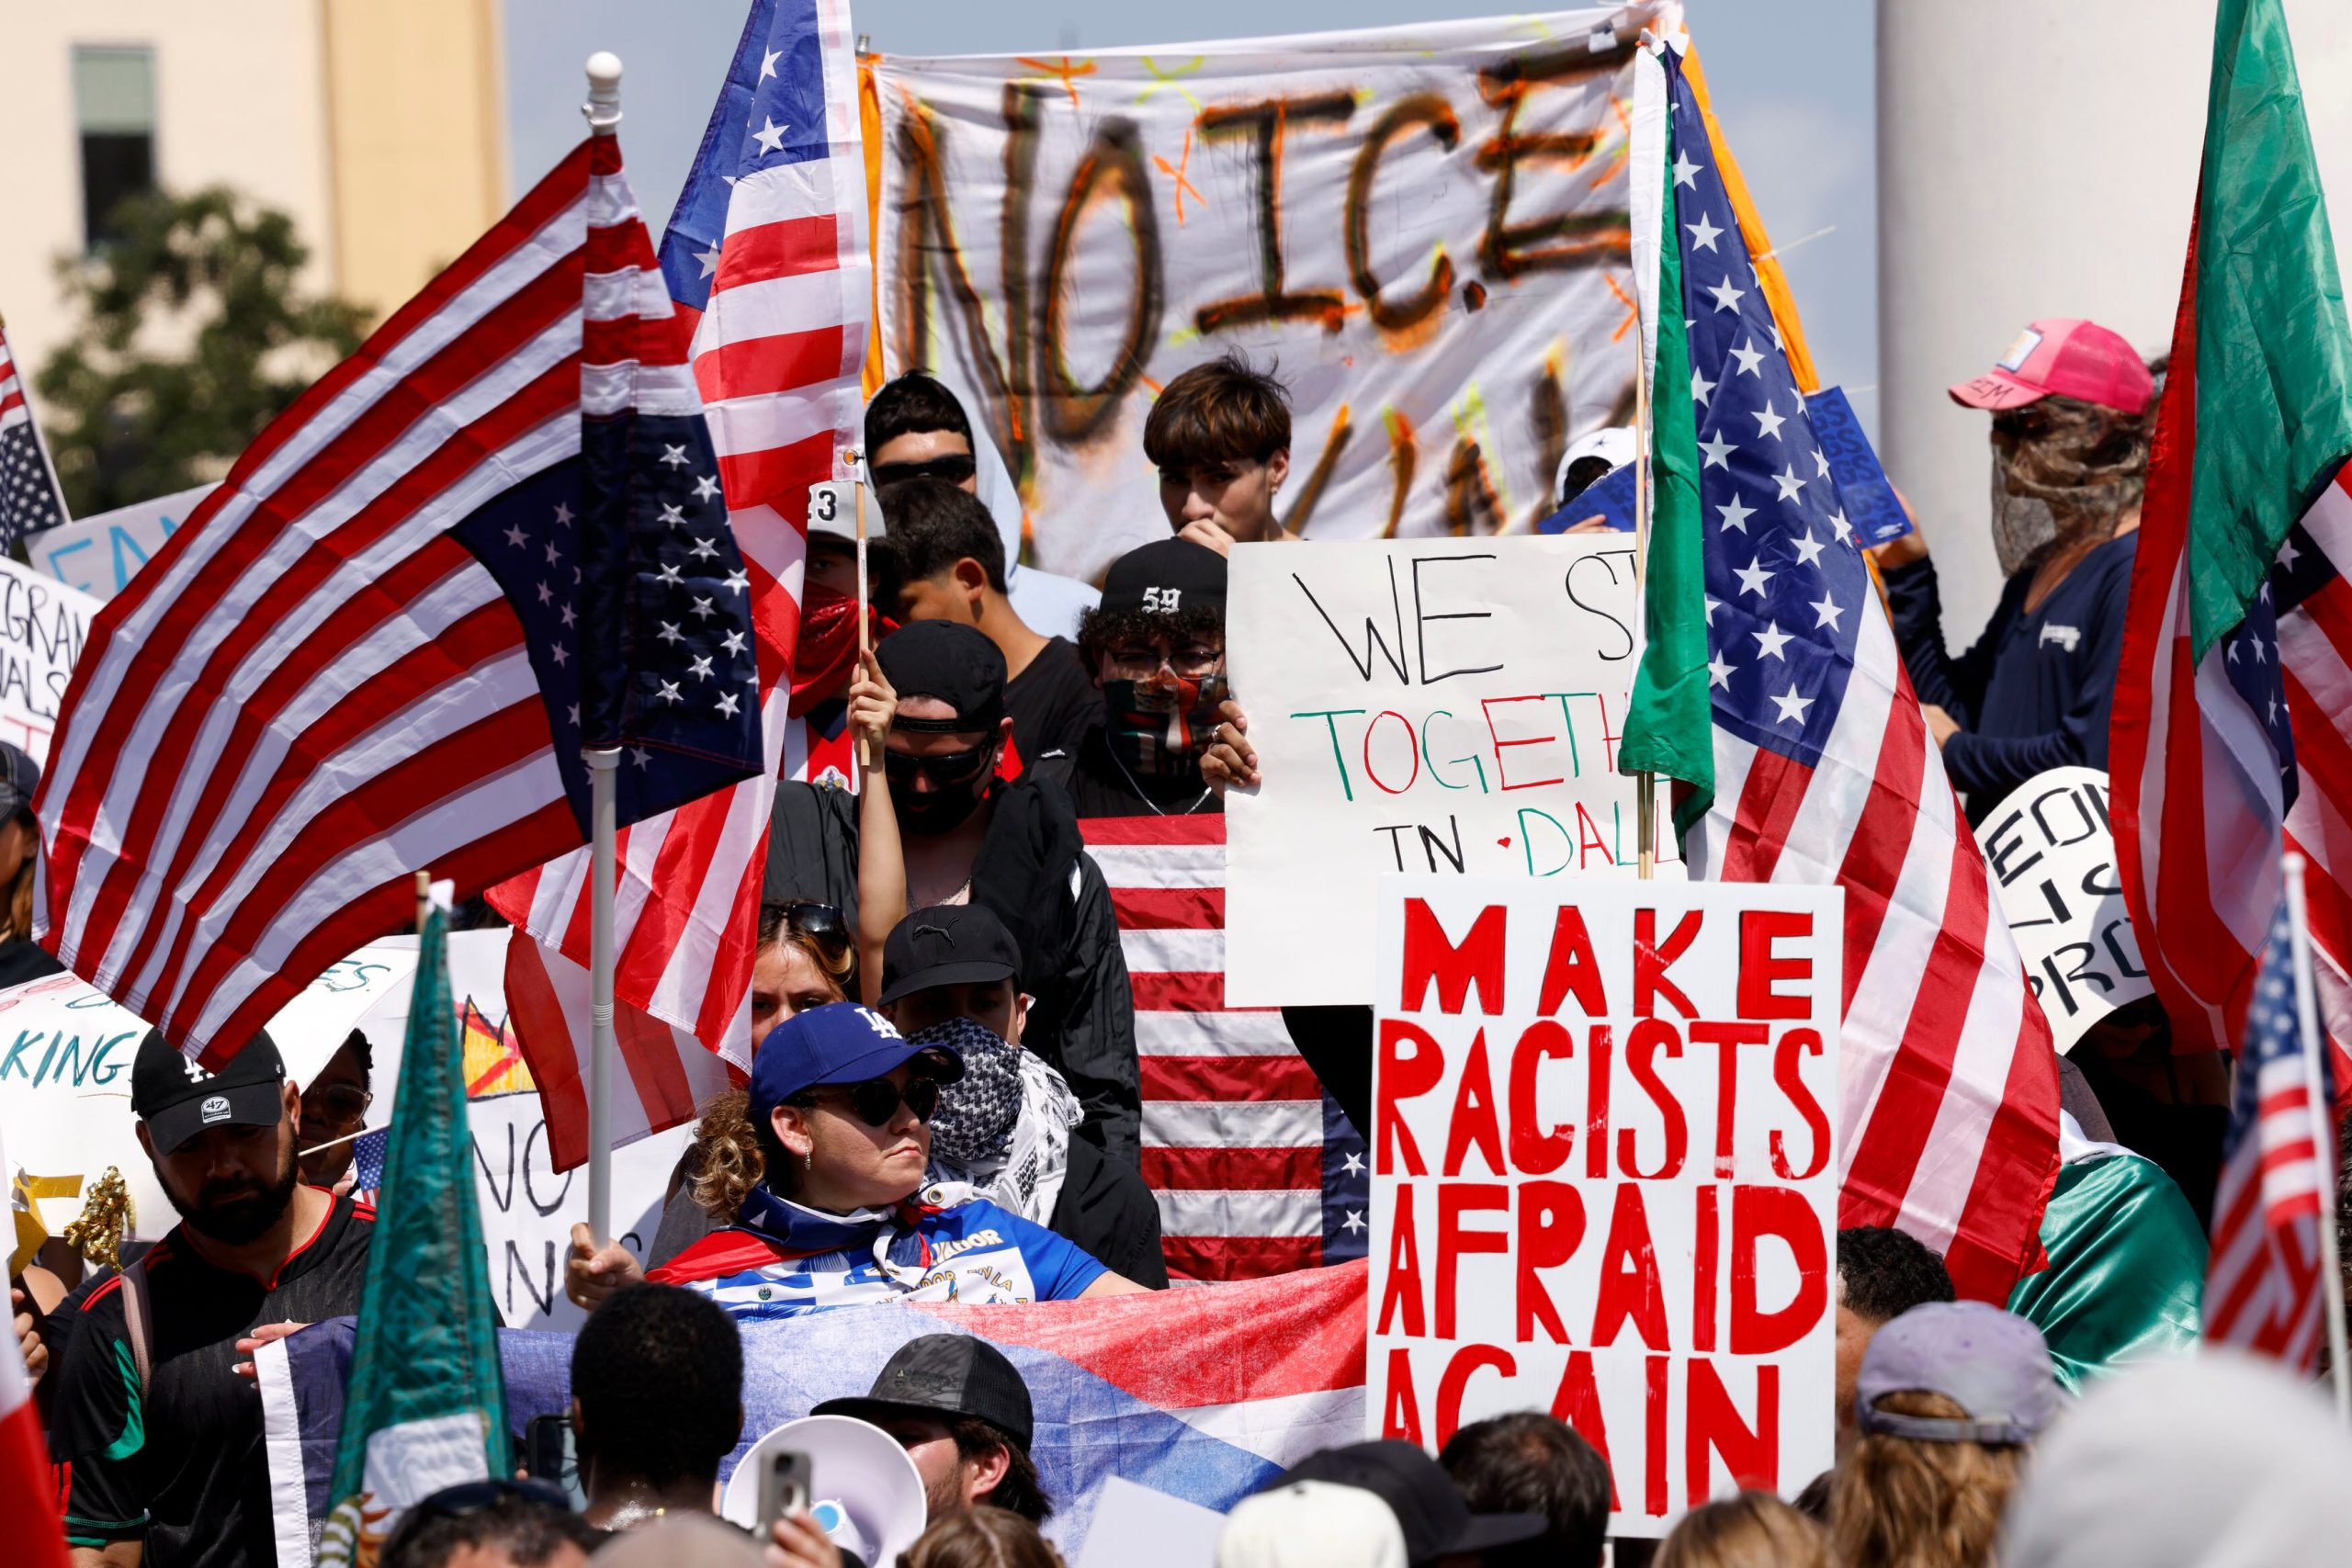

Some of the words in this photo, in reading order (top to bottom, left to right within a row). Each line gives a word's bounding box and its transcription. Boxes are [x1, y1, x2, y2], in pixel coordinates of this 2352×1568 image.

[895, 81, 1164, 487] NO
[808, 489, 837, 522] 3
[1141, 586, 1182, 615] 59
[1292, 554, 1504, 685] WE
[1290, 691, 1671, 802] TOGETH
[1400, 897, 1814, 1020] MAKE
[0, 1029, 138, 1089] KING
[854, 1007, 903, 1040] LA
[1376, 1018, 1831, 1179] RACISTS
[469, 1119, 574, 1217] NO
[1375, 1180, 1828, 1355] AFRAID
